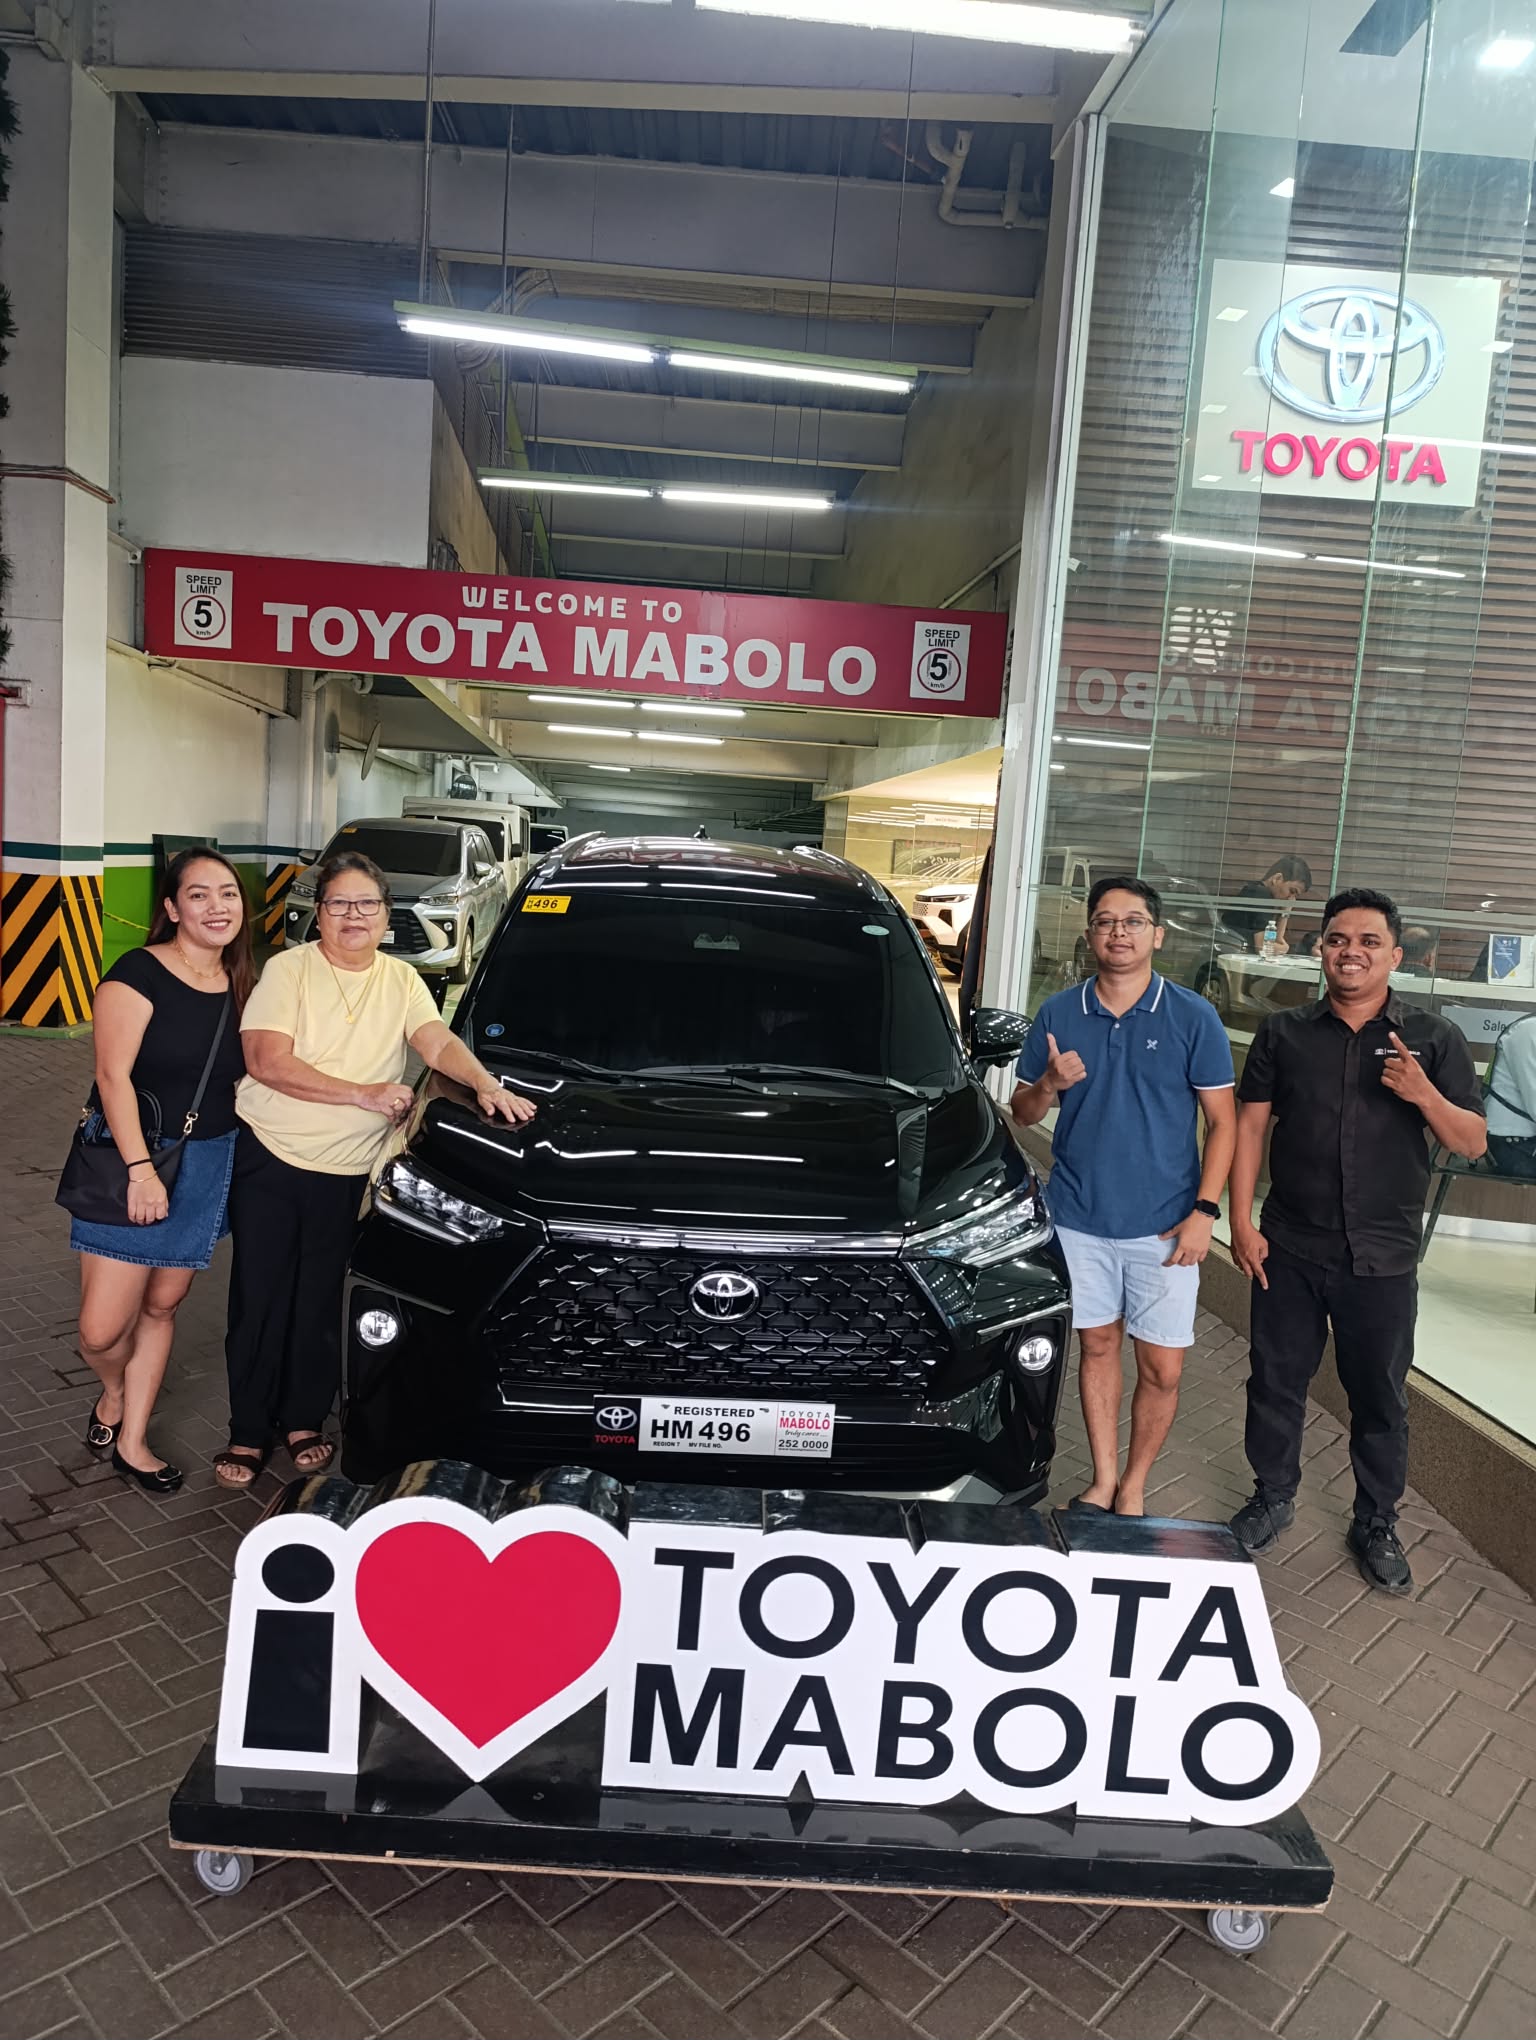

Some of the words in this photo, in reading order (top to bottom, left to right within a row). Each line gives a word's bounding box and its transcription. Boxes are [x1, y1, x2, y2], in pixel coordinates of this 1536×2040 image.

[1232, 430, 1447, 485] TOYOTA
[186, 574, 222, 586] SPEED
[190, 584, 218, 595] LIMIT
[462, 586, 627, 619] WELCOME
[641, 600, 682, 623] TO
[193, 600, 213, 628] 5
[924, 628, 961, 639] SPEED
[262, 602, 548, 673] TOYOTA
[573, 625, 877, 696] MABOLO
[928, 638, 956, 648] LIMIT
[929, 653, 948, 681] 5
[533, 899, 559, 909] 496
[674, 1406, 755, 1418] REGISTERED
[780, 1410, 830, 1418] TOYOTA
[780, 1417, 830, 1430] MABOLO
[650, 1419, 693, 1439] HM
[698, 1421, 751, 1442] 496
[594, 1434, 636, 1445] TOYOTA
[778, 1439, 799, 1448] 252
[802, 1440, 829, 1449] 0000
[654, 1547, 1260, 1688] TOYOTA
[242, 1543, 335, 1753] i
[629, 1662, 1295, 1801] MABOLO
